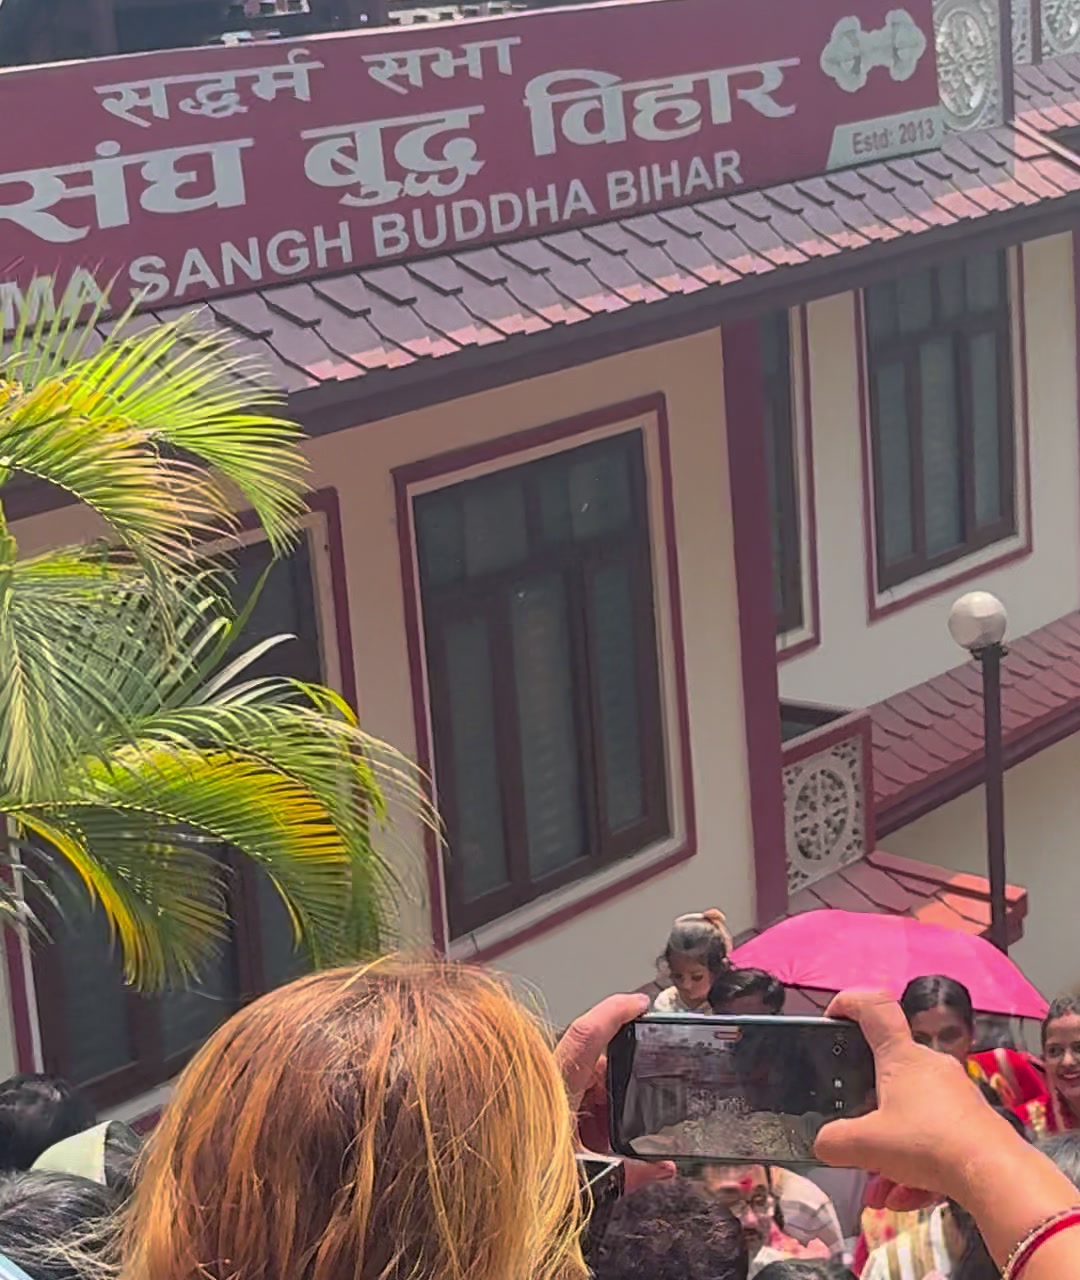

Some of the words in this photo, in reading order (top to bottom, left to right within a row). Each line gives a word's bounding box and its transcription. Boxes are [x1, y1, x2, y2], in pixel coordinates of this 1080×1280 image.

[361, 36, 521, 94] सभा
[0, 138, 255, 243] संघ
[301, 105, 486, 207] बुद्ध
[523, 57, 800, 156] विहार
[898, 118, 935, 145] 2013
[129, 220, 352, 302] SANGH
[372, 178, 597, 258] BUDDHA
[606, 149, 744, 211] BIHAR
